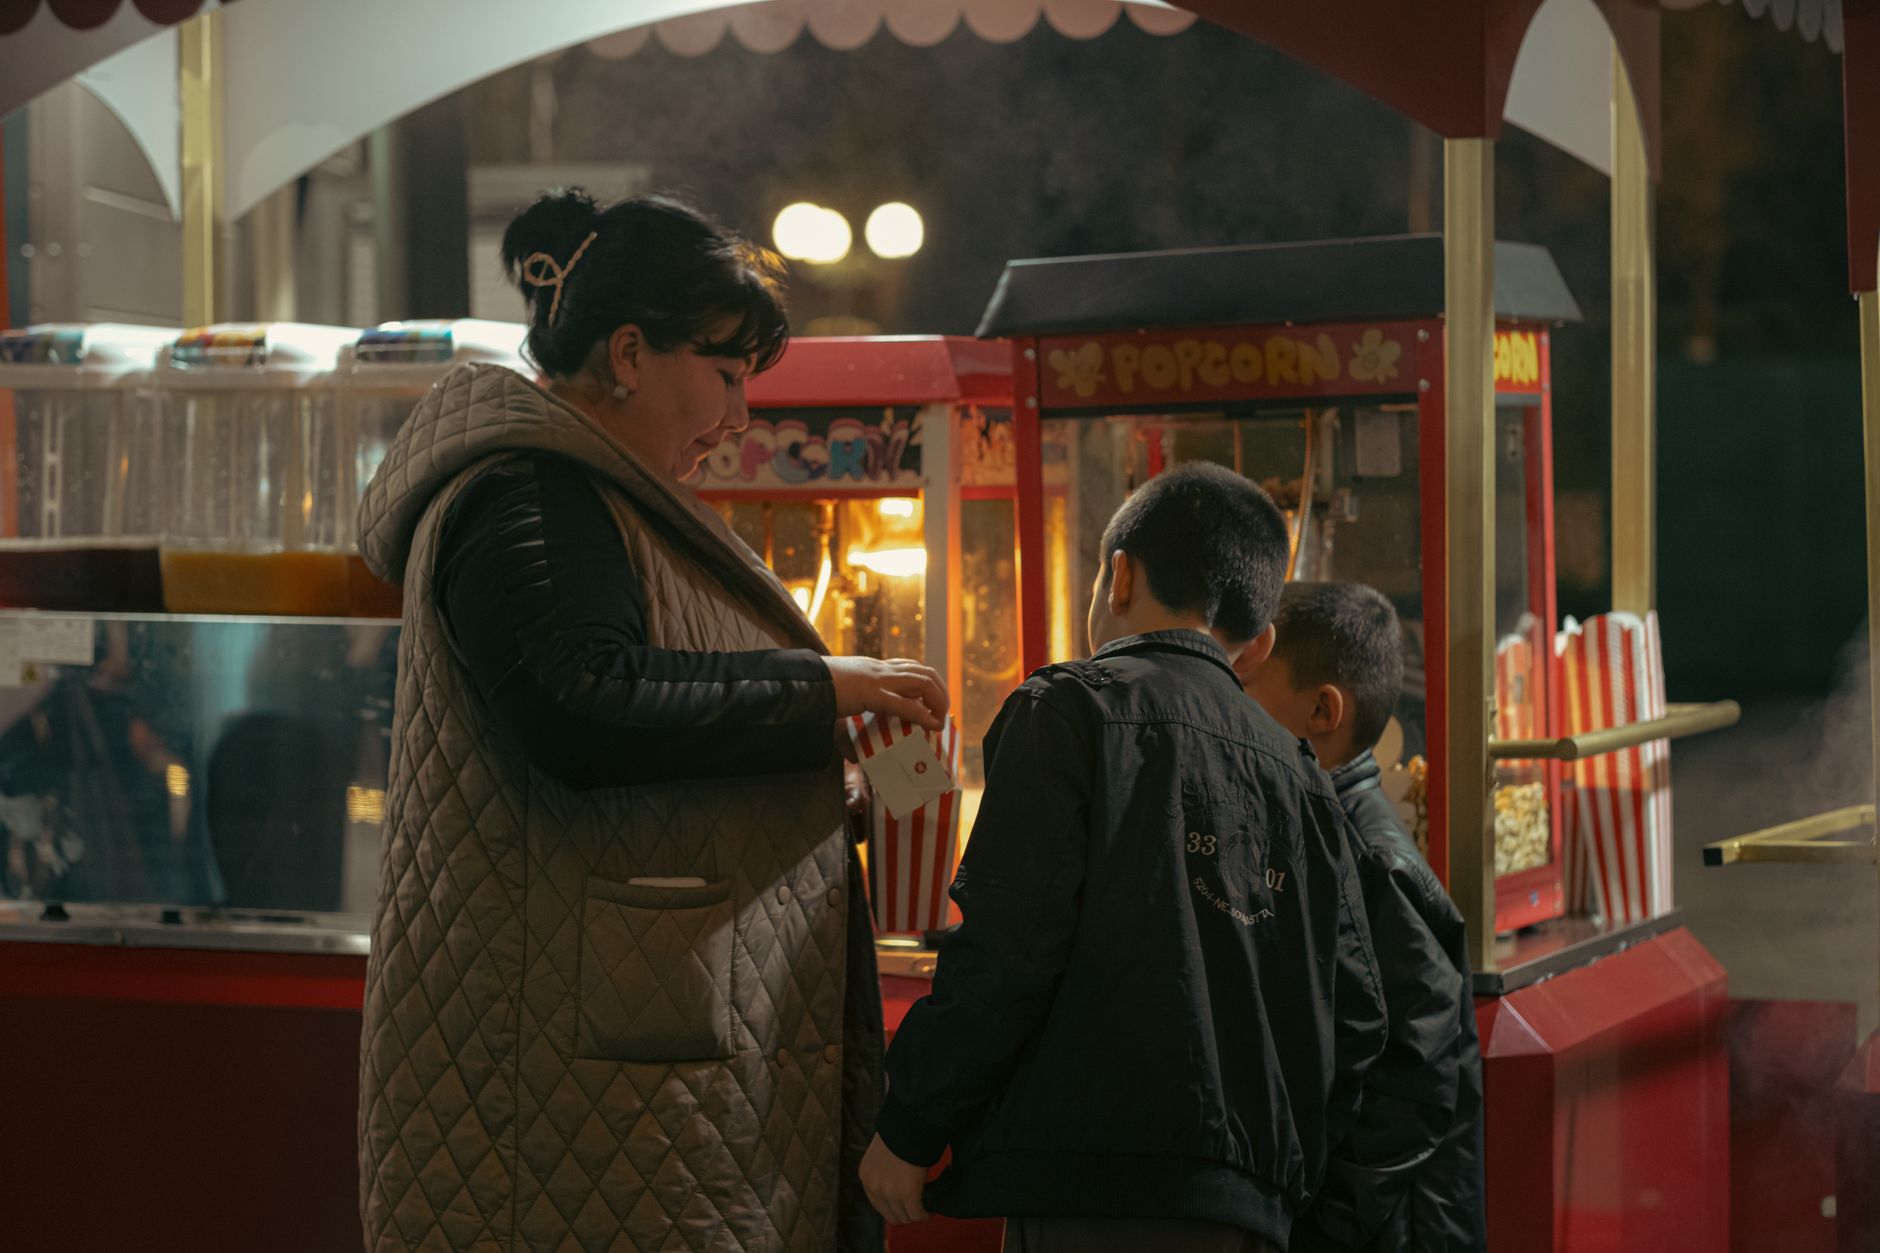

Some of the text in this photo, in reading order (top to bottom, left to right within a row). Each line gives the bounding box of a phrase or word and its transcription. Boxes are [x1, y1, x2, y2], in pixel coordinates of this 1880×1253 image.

[1112, 333, 1340, 393] POPCORN
[690, 418, 910, 484] OPCORN
[1186, 832, 1217, 856] 33
[1265, 868, 1286, 892] 01
